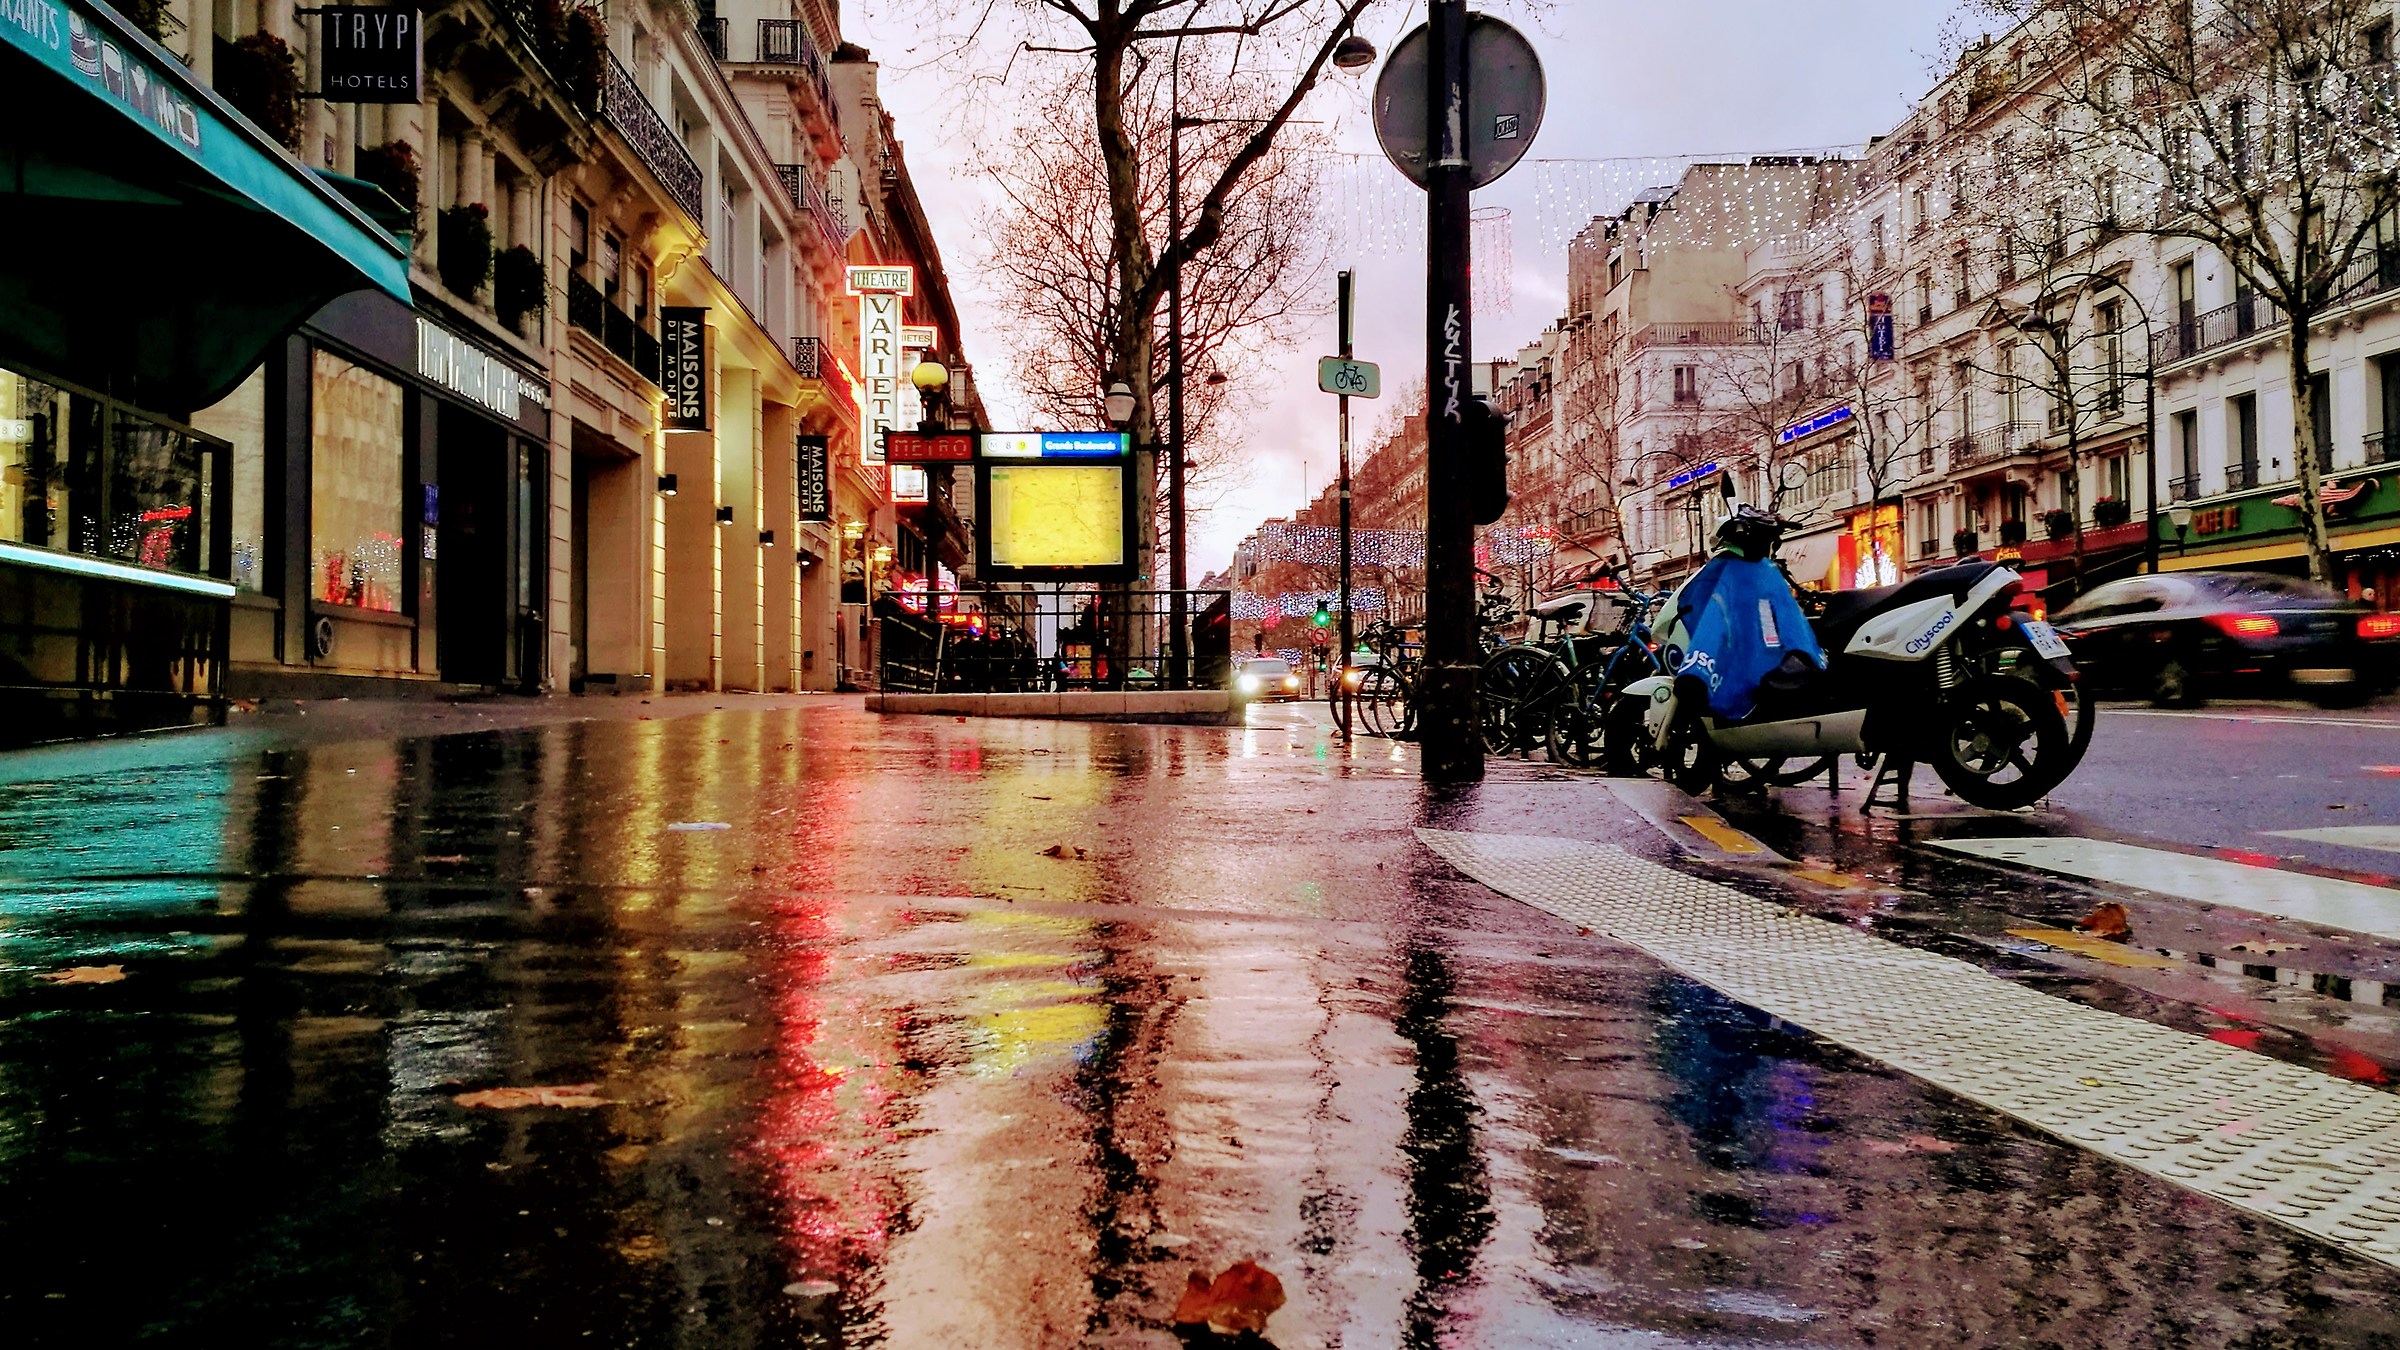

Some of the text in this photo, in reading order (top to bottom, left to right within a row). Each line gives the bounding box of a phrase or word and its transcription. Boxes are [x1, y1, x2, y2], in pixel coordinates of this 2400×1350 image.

[332, 13, 408, 49] TRYP
[331, 75, 408, 88] HOTELS
[856, 272, 907, 288] THEATRE
[902, 334, 931, 343] IETES
[667, 320, 677, 418] DU MONDE
[682, 321, 700, 418] MAISONS
[894, 439, 968, 457] METRO
[1005, 441, 1011, 450] 8
[812, 446, 824, 512] MAISONS
[1905, 611, 1954, 654] Cityscoot
